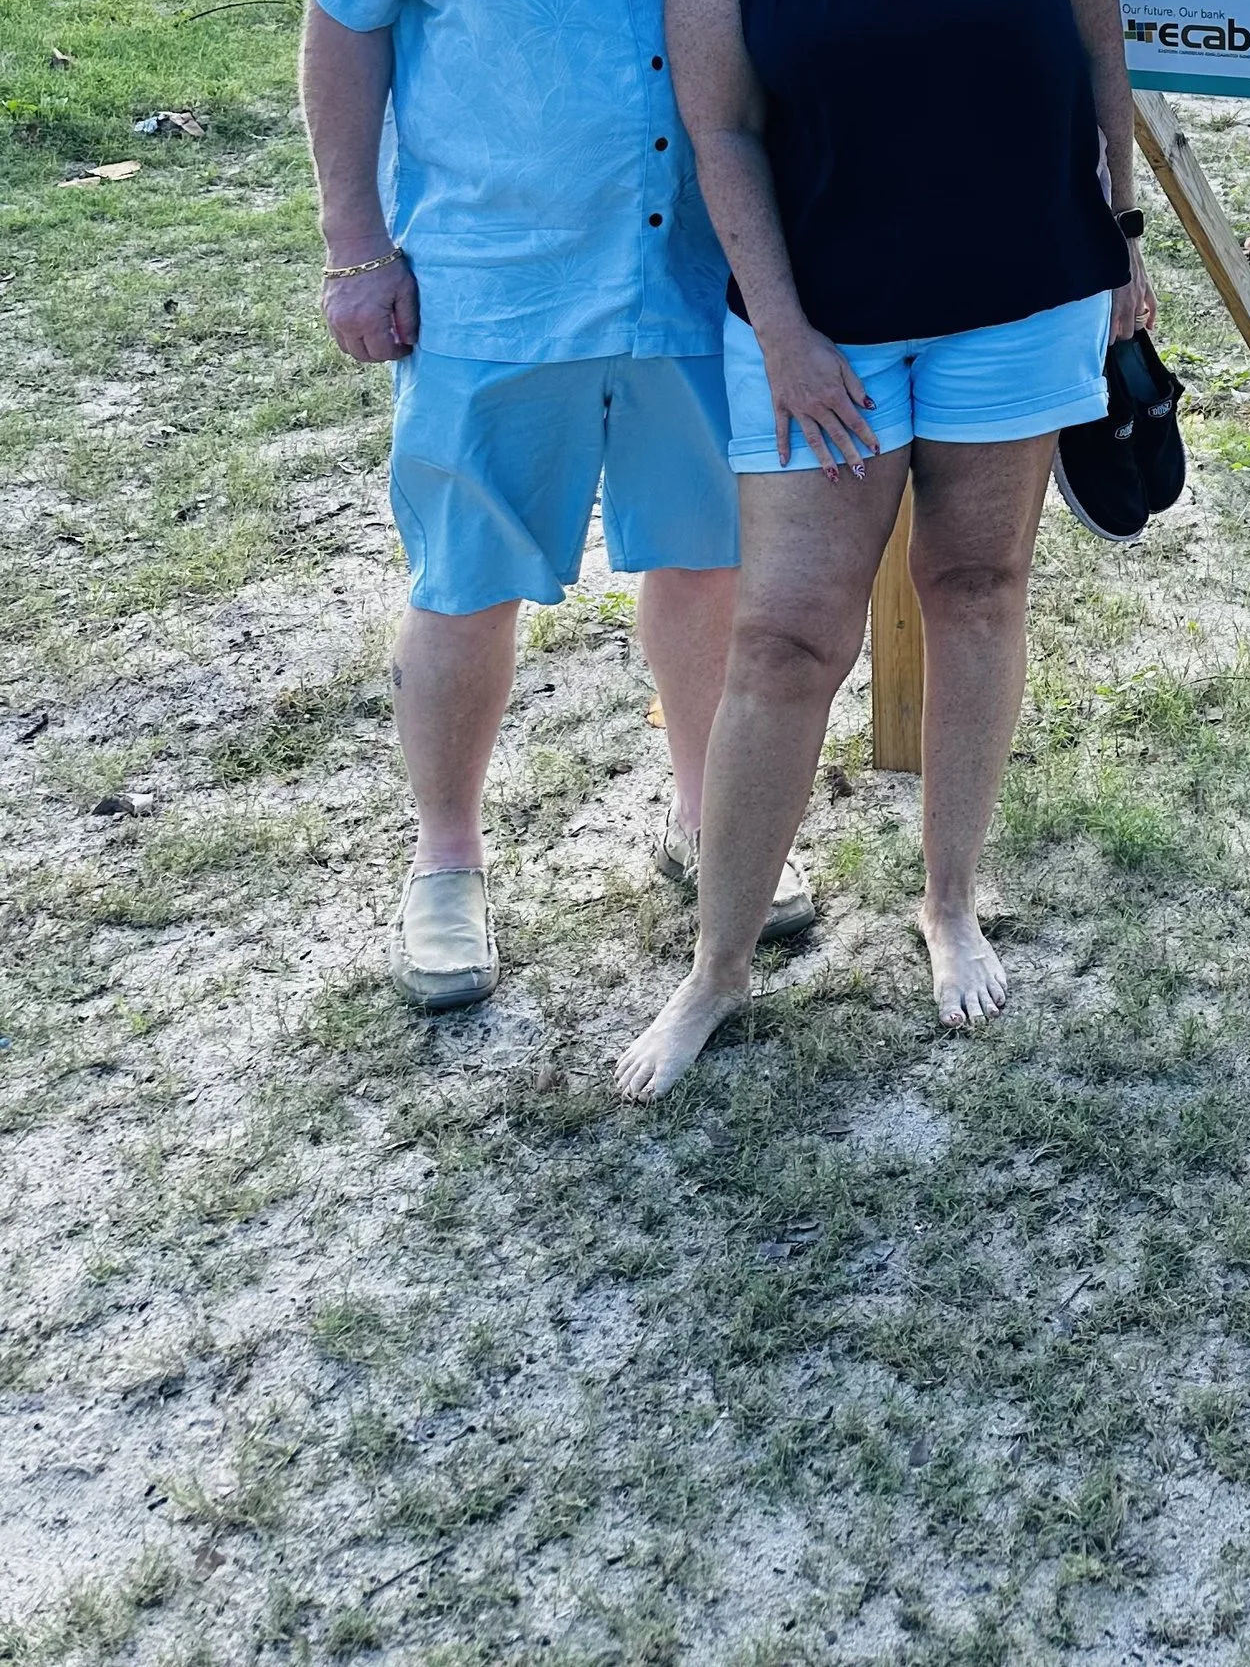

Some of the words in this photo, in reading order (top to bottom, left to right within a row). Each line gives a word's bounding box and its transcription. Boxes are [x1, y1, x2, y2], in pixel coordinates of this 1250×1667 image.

[1122, 3, 1141, 15] Our
[1178, 6, 1198, 18] Our
[1201, 9, 1225, 20] bank
